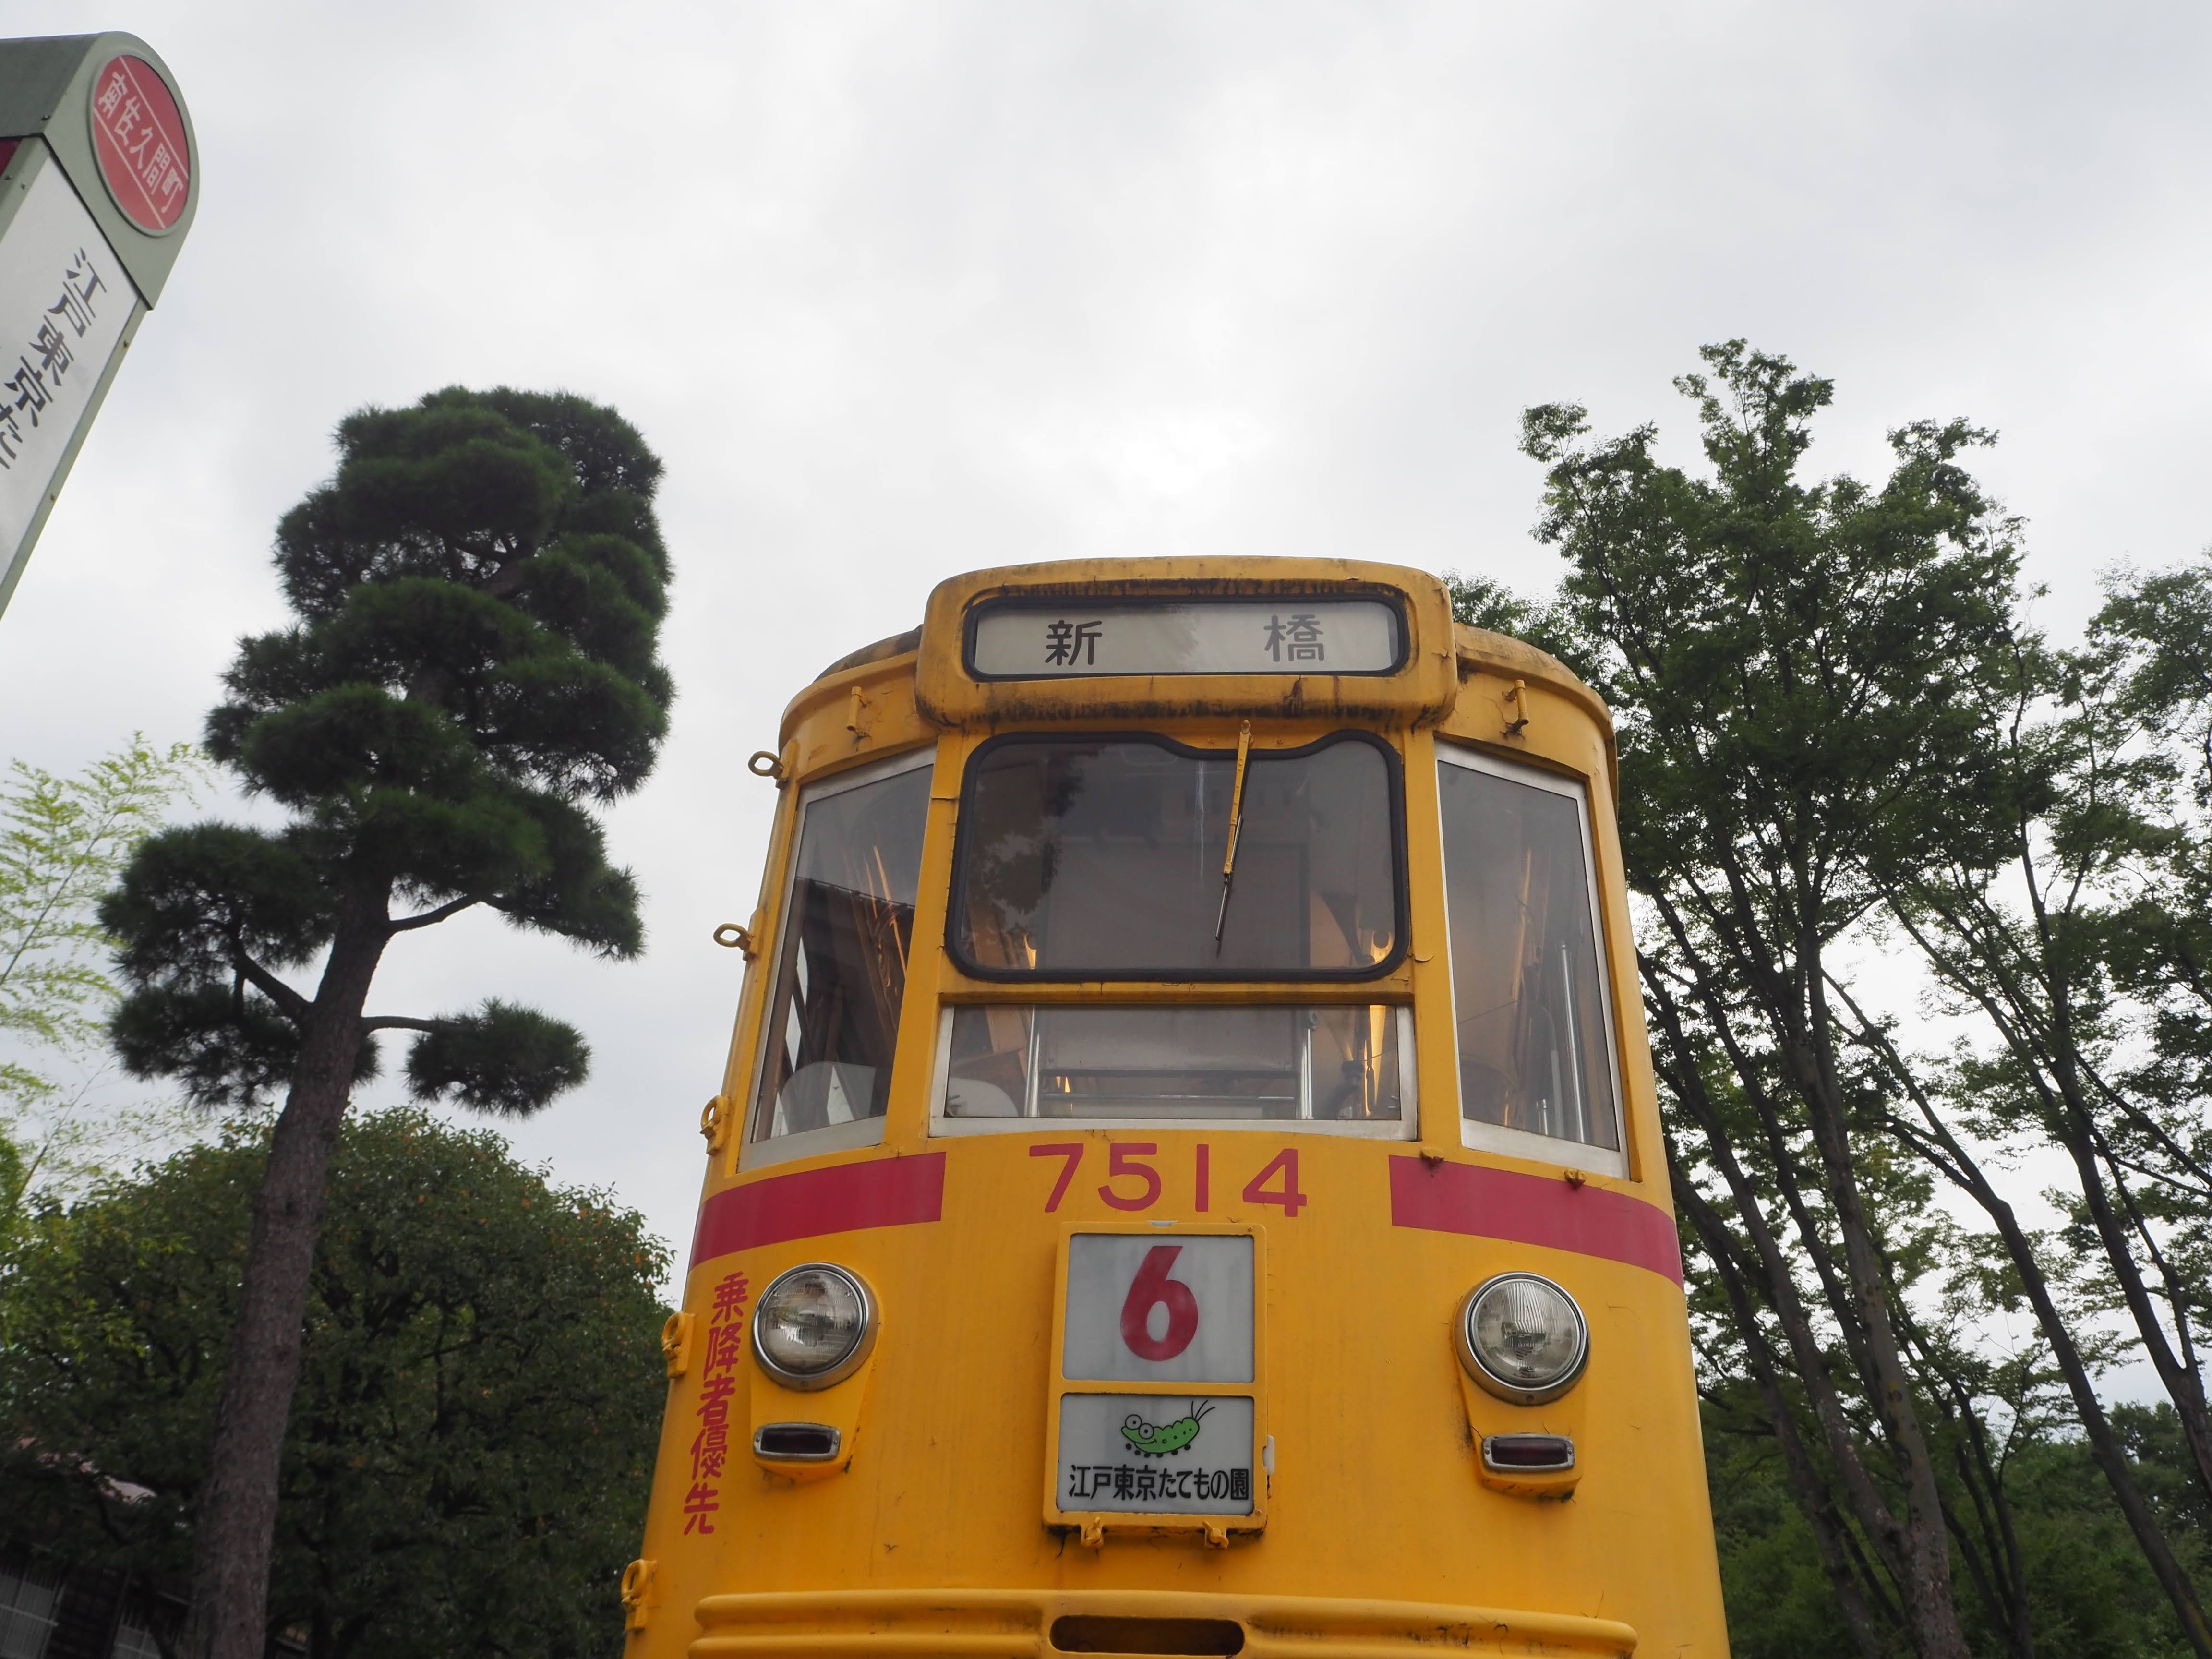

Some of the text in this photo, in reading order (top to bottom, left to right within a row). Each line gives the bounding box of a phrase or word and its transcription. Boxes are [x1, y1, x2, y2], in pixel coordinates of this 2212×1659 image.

[0, 247, 107, 469] 江戸東京た
[1029, 1143, 1307, 1217] 7514
[1120, 1246, 1199, 1361] 6
[684, 1272, 748, 1536] 乗降者優先
[1068, 1464, 1249, 1501] 江戸東京たてもの園
